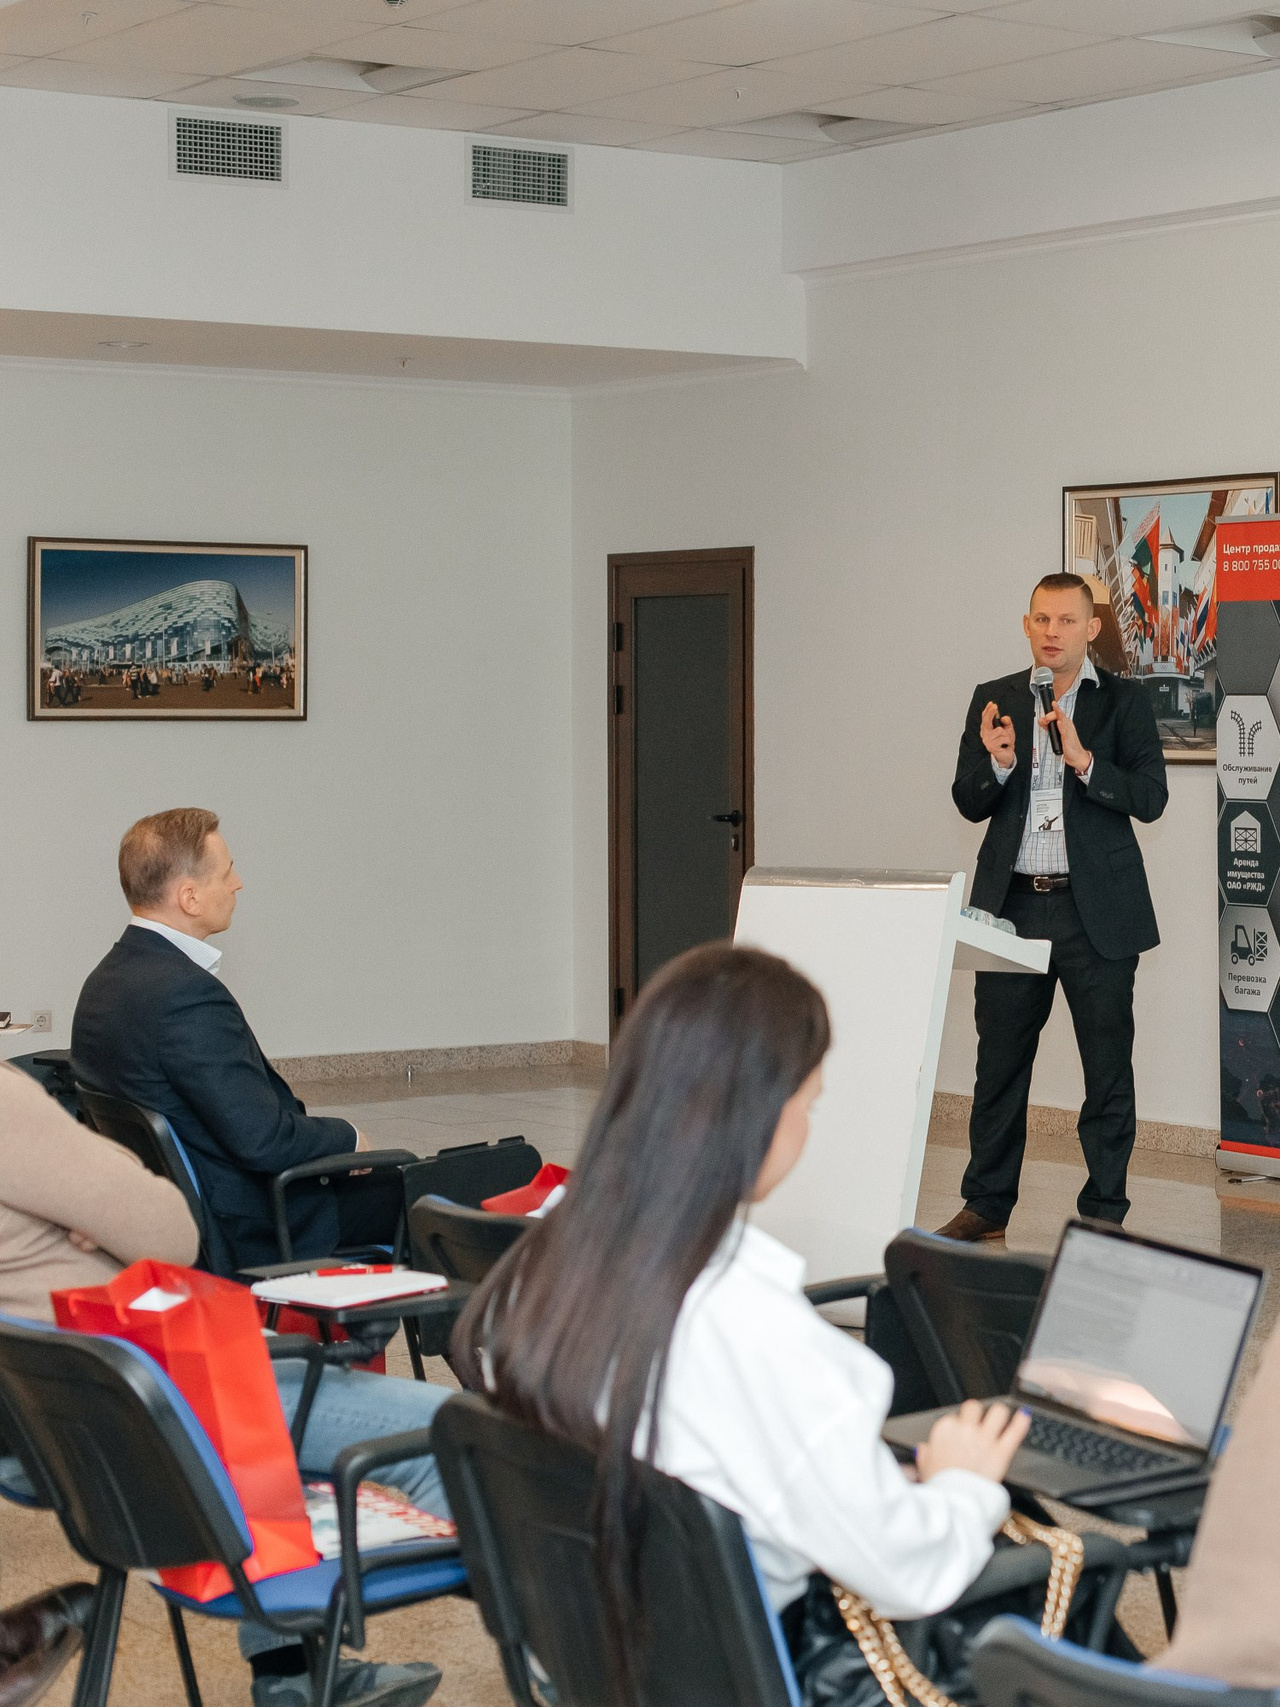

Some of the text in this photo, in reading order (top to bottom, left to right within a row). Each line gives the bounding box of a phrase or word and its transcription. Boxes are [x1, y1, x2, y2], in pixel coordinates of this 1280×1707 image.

[1223, 543, 1251, 555] Центр
[1223, 561, 1229, 571] 8
[1231, 560, 1250, 571] 800
[1252, 559, 1270, 570] 755
[1222, 763, 1272, 774] Обслуживание
[1238, 776, 1258, 785] путей
[1233, 857, 1259, 868] Аренда
[1227, 870, 1265, 880] имущества
[1226, 881, 1242, 890] ОАО
[1228, 972, 1267, 984] Перевозка
[1234, 986, 1261, 996] багажа
